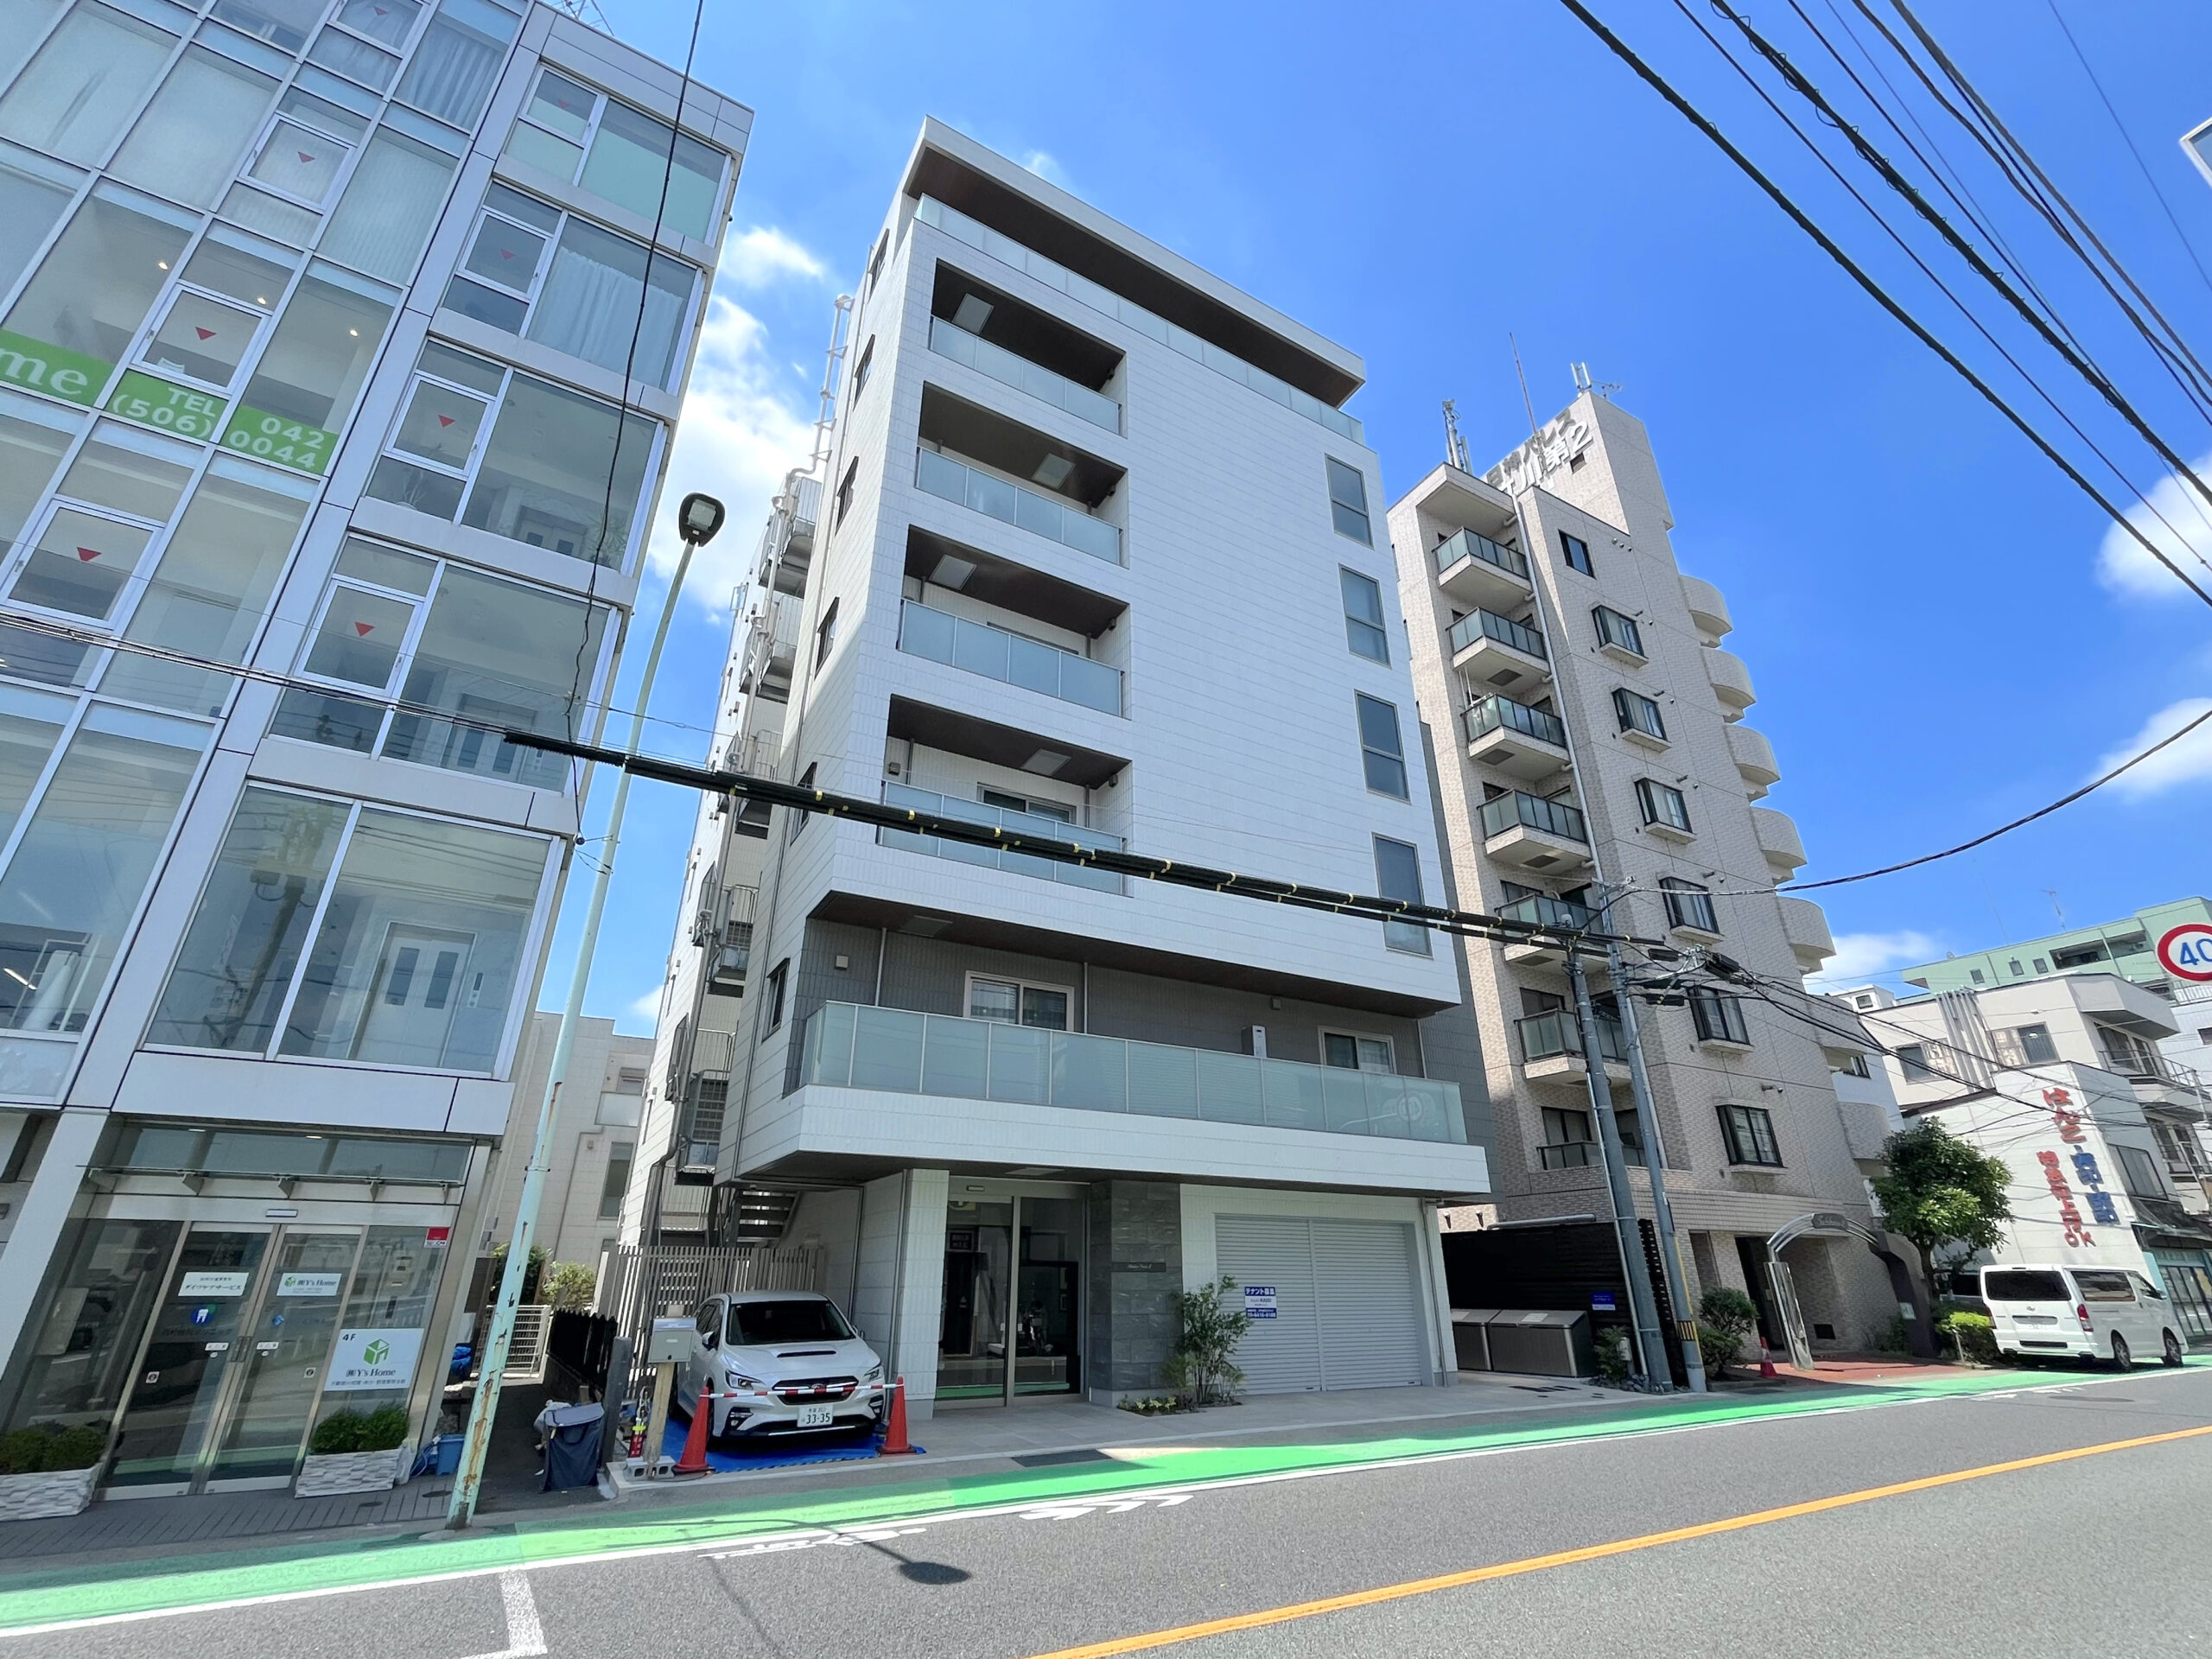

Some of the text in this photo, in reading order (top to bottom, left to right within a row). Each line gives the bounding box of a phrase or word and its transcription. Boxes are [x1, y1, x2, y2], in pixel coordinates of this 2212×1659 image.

[167, 386, 326, 450] TEL 042
[370, 1368, 396, 1376] Home
[806, 1413, 830, 1424] 33-35
